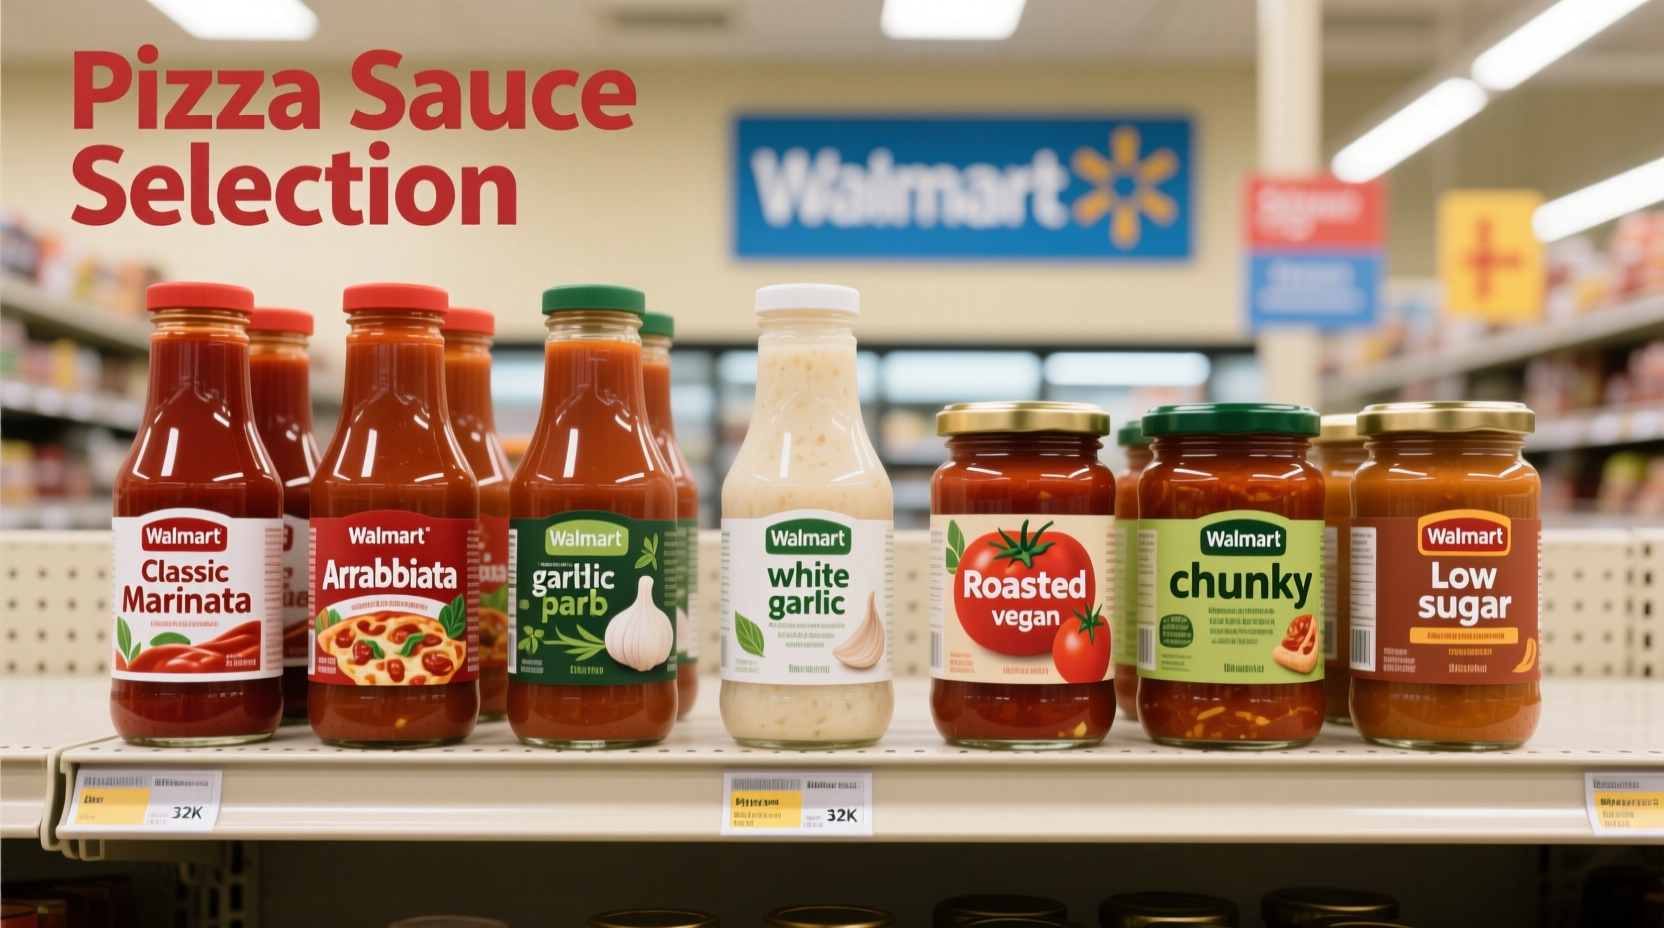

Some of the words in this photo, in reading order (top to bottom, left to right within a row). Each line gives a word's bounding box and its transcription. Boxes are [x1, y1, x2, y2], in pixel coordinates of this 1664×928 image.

[750, 147, 1069, 229] Walmart
[146, 527, 221, 545] Walmart
[349, 526, 425, 545] Walmart
[549, 529, 622, 548] Walmart
[771, 528, 845, 547] Walmart
[1206, 530, 1281, 549] Walmart
[1427, 528, 1503, 545] Walmart
[141, 559, 229, 583] Classic
[322, 558, 457, 590] Arrabbiata
[767, 561, 850, 588] white
[1431, 561, 1497, 589] Low
[963, 569, 1086, 599] Roasted
[1170, 561, 1313, 609] chunky
[123, 585, 251, 614] Marinata
[541, 588, 608, 624] parb
[768, 589, 845, 620] garlic
[1418, 594, 1512, 627] sugar
[991, 609, 1060, 633] vegan
[171, 805, 203, 820] 32K
[826, 808, 858, 823] 32K
